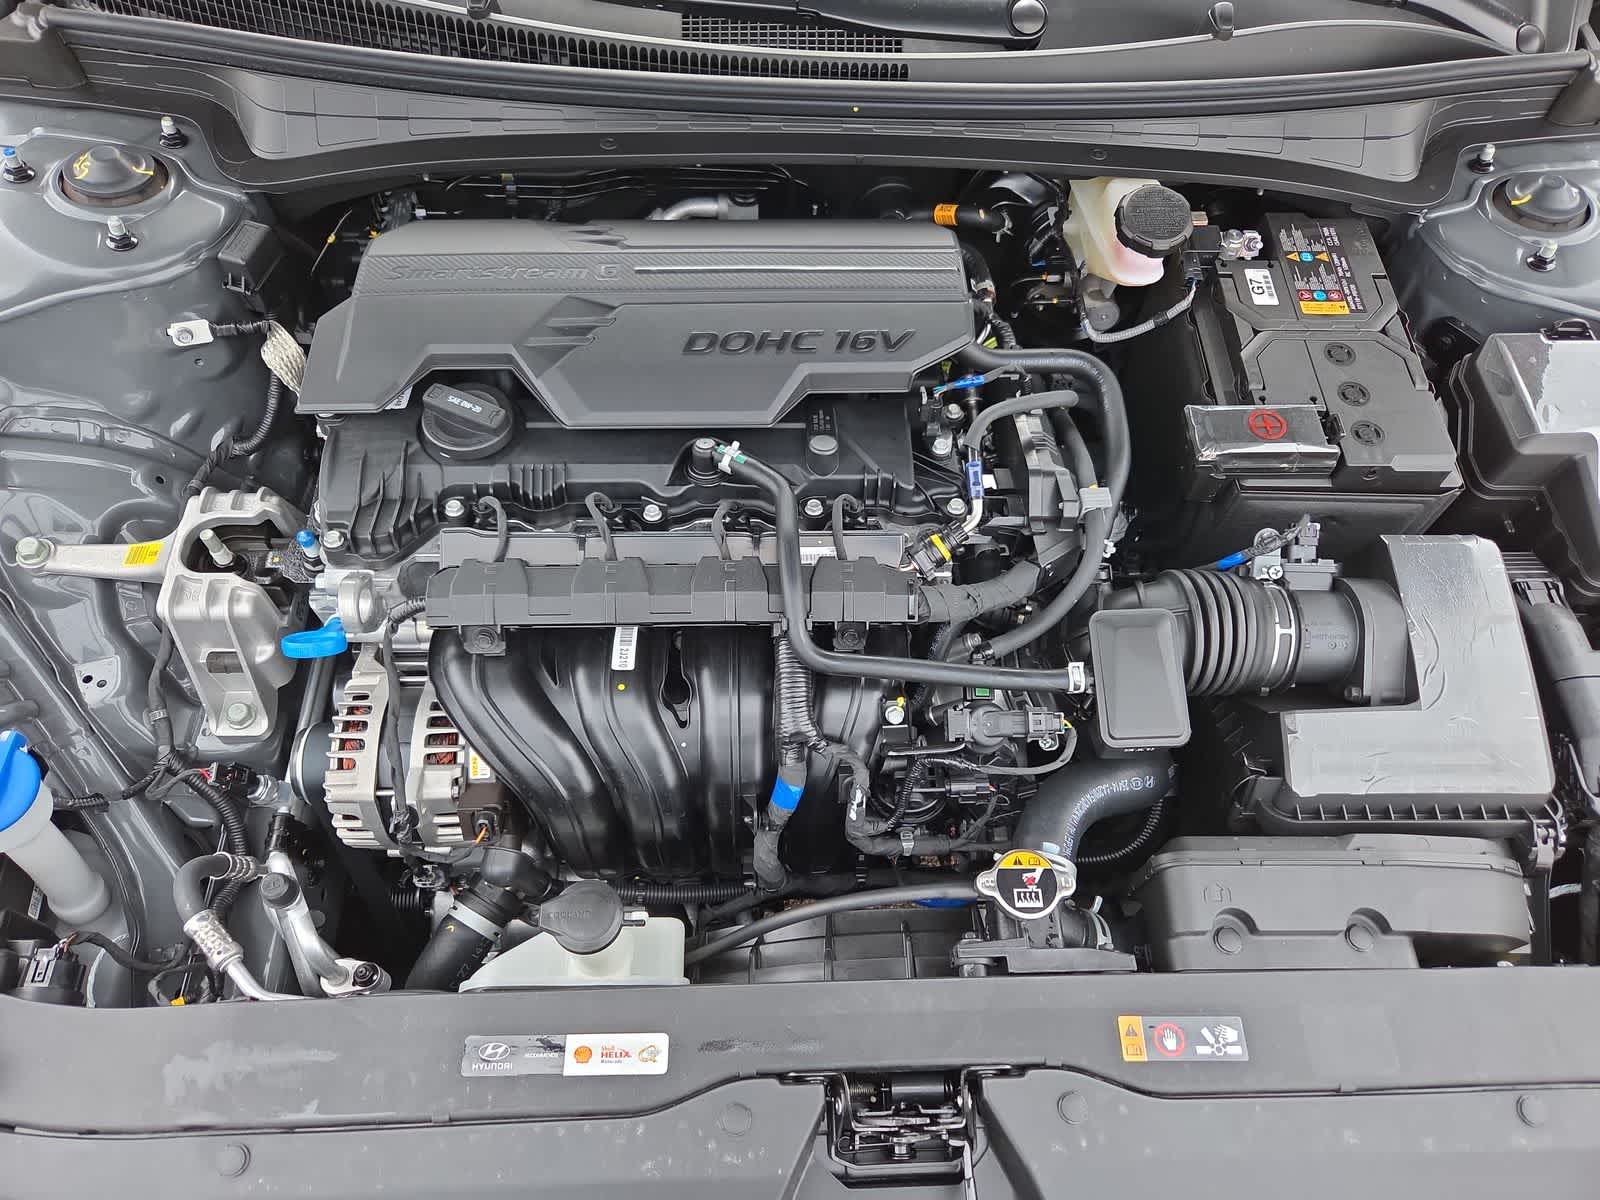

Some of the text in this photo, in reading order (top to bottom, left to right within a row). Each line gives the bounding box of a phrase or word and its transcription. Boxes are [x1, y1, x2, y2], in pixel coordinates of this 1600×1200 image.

[384, 265, 590, 282] Smartstream
[1251, 278, 1265, 296] G7
[682, 329, 917, 355] DOHC 16V
[601, 1051, 632, 1059] HELIX
[471, 1062, 513, 1072] HYUNDAI
